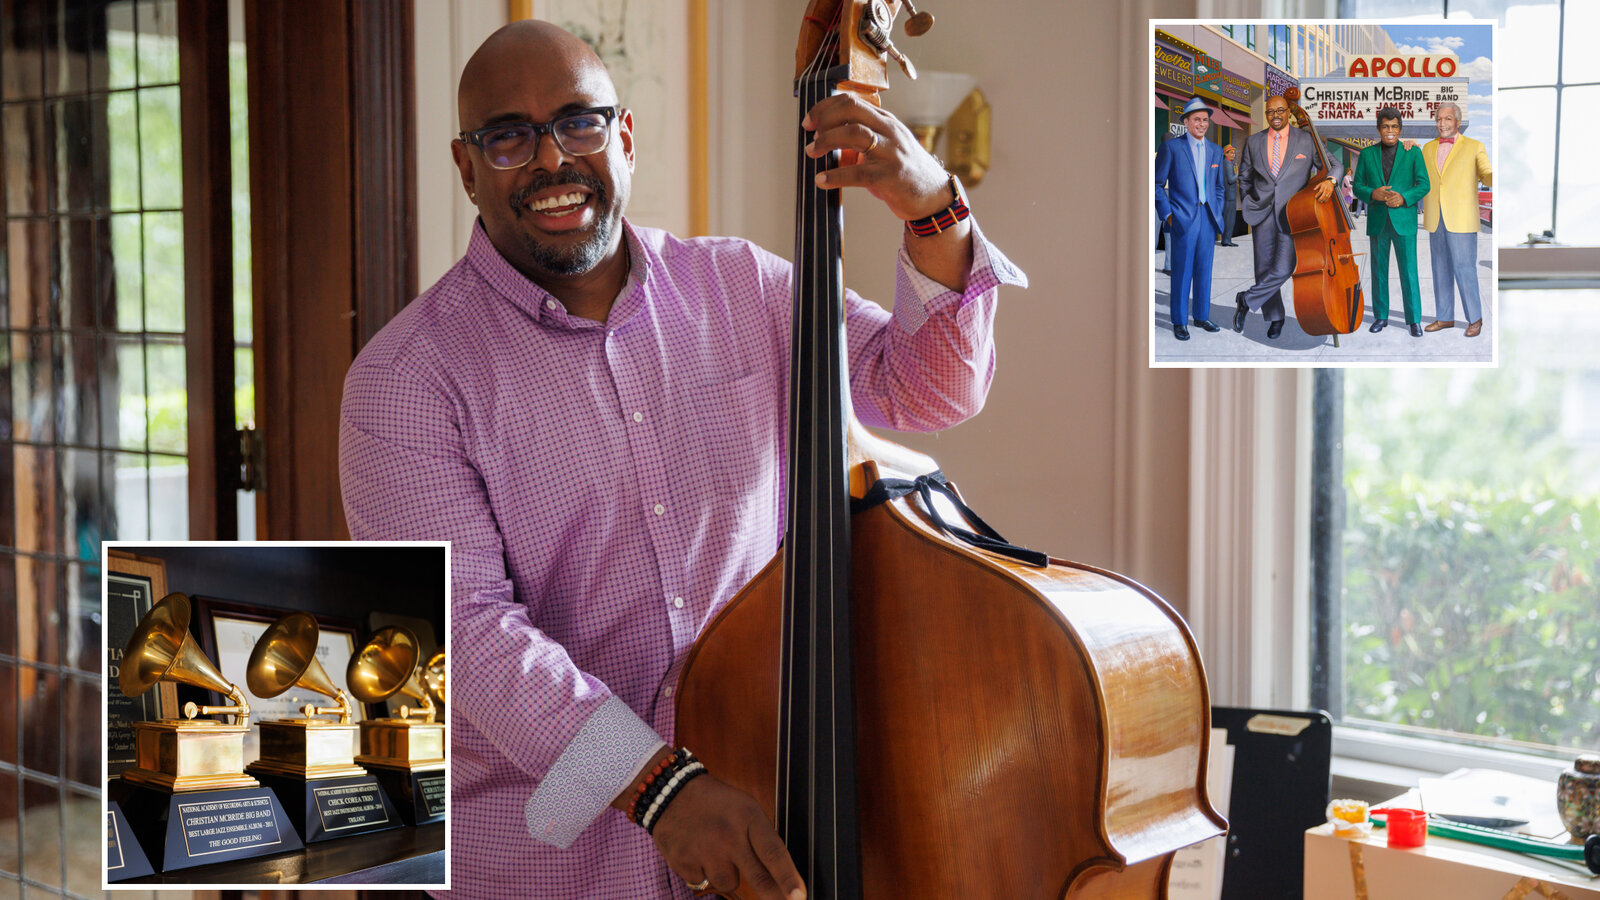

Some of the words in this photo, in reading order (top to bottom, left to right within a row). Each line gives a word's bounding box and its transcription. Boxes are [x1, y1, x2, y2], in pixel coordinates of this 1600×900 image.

[1195, 53, 1220, 71] MILES
[1349, 57, 1456, 77] APOLLO
[1224, 75, 1250, 90] HUBBARD
[1304, 86, 1369, 101] CHRISTIAN
[1321, 102, 1356, 110] FRANK
[1376, 102, 1412, 110] JAMES
[1318, 110, 1364, 119] SINATRA
[328, 797, 345, 806] CHICK
[345, 796, 362, 804] COREA
[186, 816, 218, 826] CHRISTIAN
[245, 811, 256, 819] BIG
[256, 809, 271, 817] BAND
[348, 815, 366, 823] TRILOGY
[188, 830, 201, 838] BEST
[201, 828, 216, 837] LARGE
[215, 827, 227, 835] JAZZ
[226, 824, 247, 833] ENSEMBLE
[248, 822, 263, 830] ALBUM
[209, 840, 221, 848] THE
[221, 838, 238, 846] GOOD
[239, 834, 262, 843] FEELING
